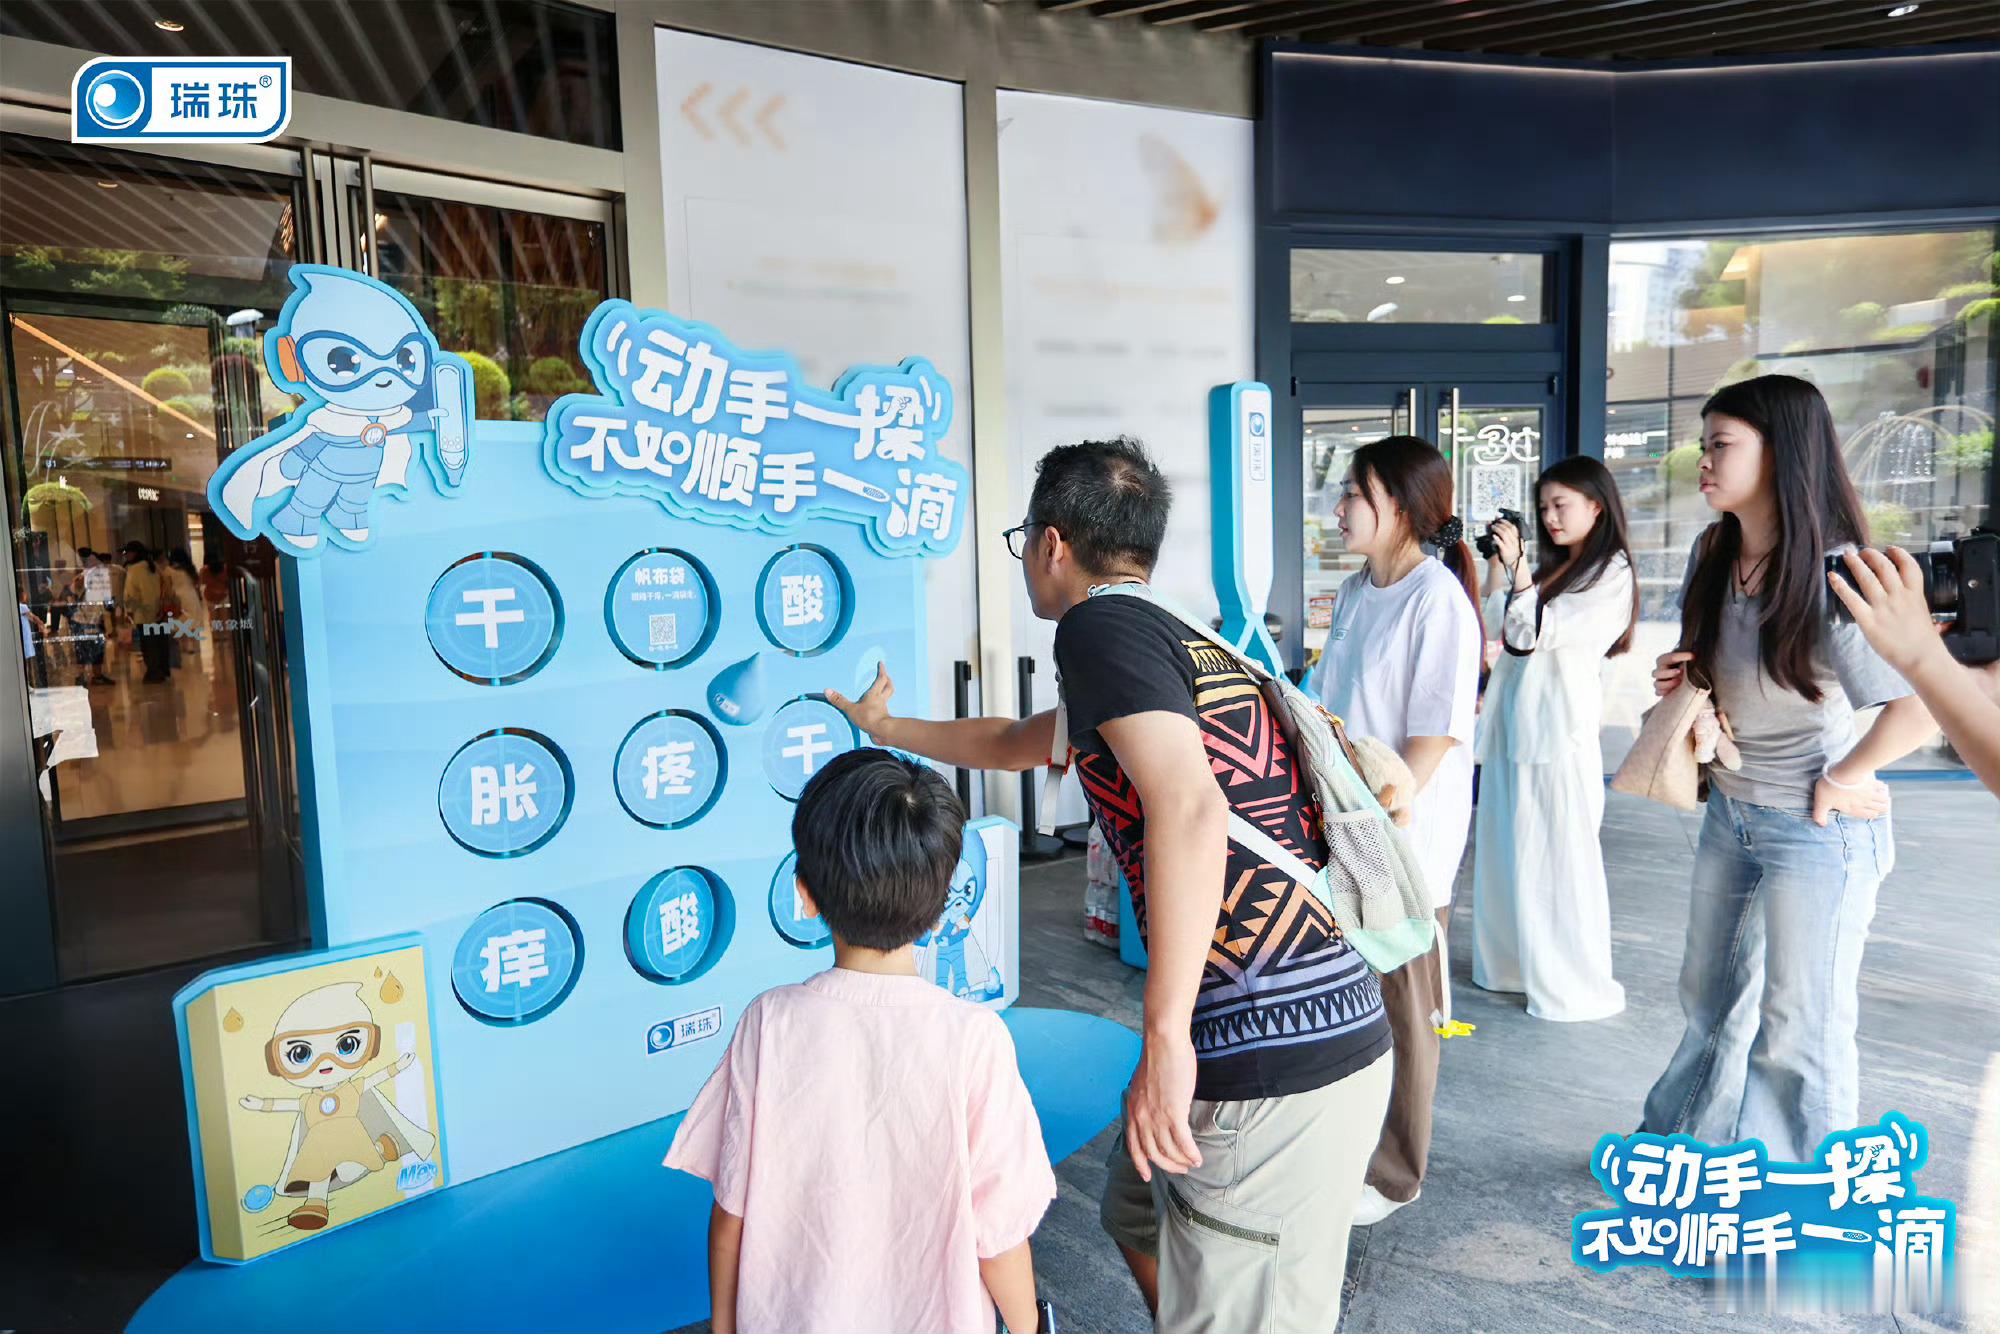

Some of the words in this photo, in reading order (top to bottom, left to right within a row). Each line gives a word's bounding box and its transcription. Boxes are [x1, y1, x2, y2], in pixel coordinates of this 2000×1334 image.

[631, 329, 925, 462] 动手一揉
[570, 415, 958, 542] 不如顺手一滴
[634, 566, 686, 586] 帆布袋
[780, 574, 826, 627] 酸
[455, 587, 525, 649] 干
[641, 741, 696, 800] 疼
[782, 723, 833, 775] 干
[470, 762, 540, 826] 胀
[659, 892, 700, 956] 酸
[479, 928, 549, 993] 痒
